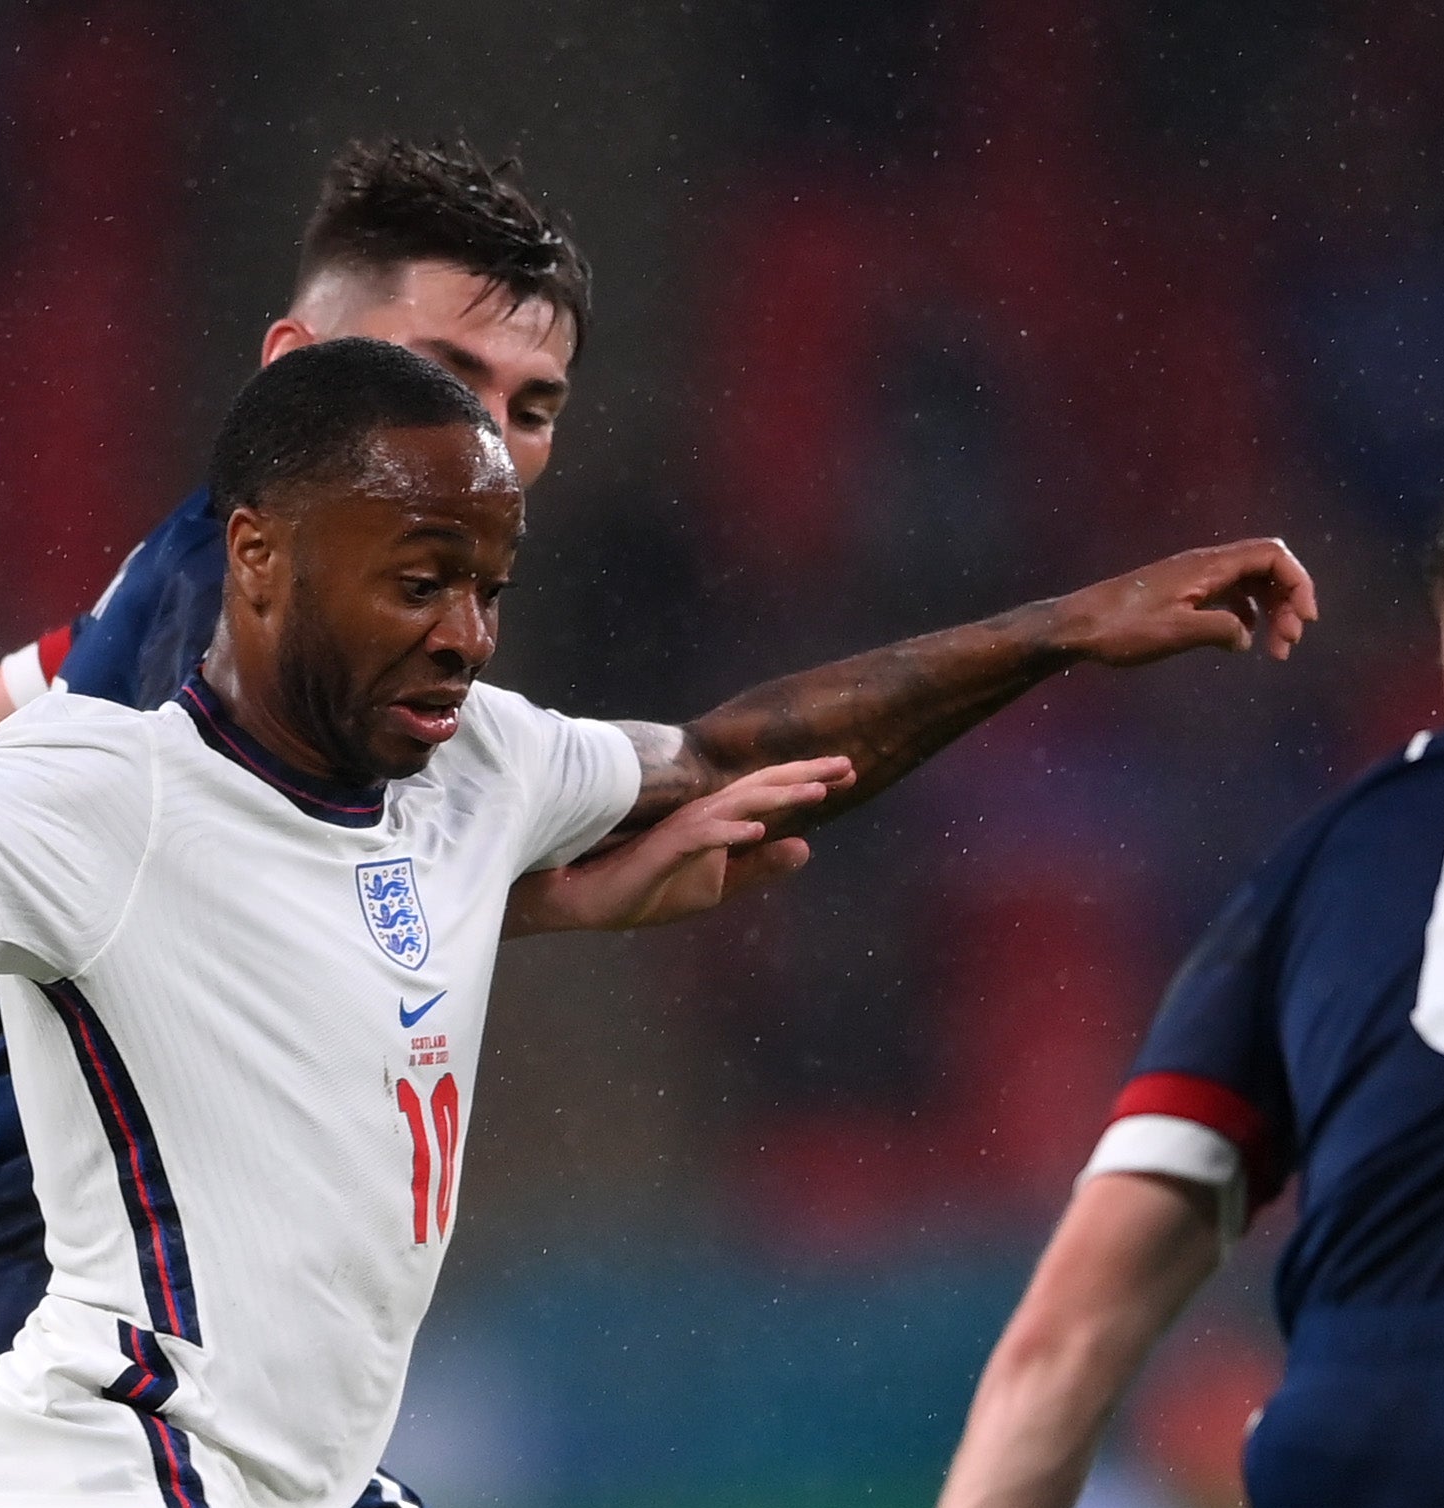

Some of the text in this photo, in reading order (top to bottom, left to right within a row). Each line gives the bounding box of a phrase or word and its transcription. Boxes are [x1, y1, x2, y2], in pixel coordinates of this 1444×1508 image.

[411, 1034, 447, 1050] SCOTLAND
[418, 1052, 434, 1066] JUNE
[397, 1072, 458, 1244] 10
